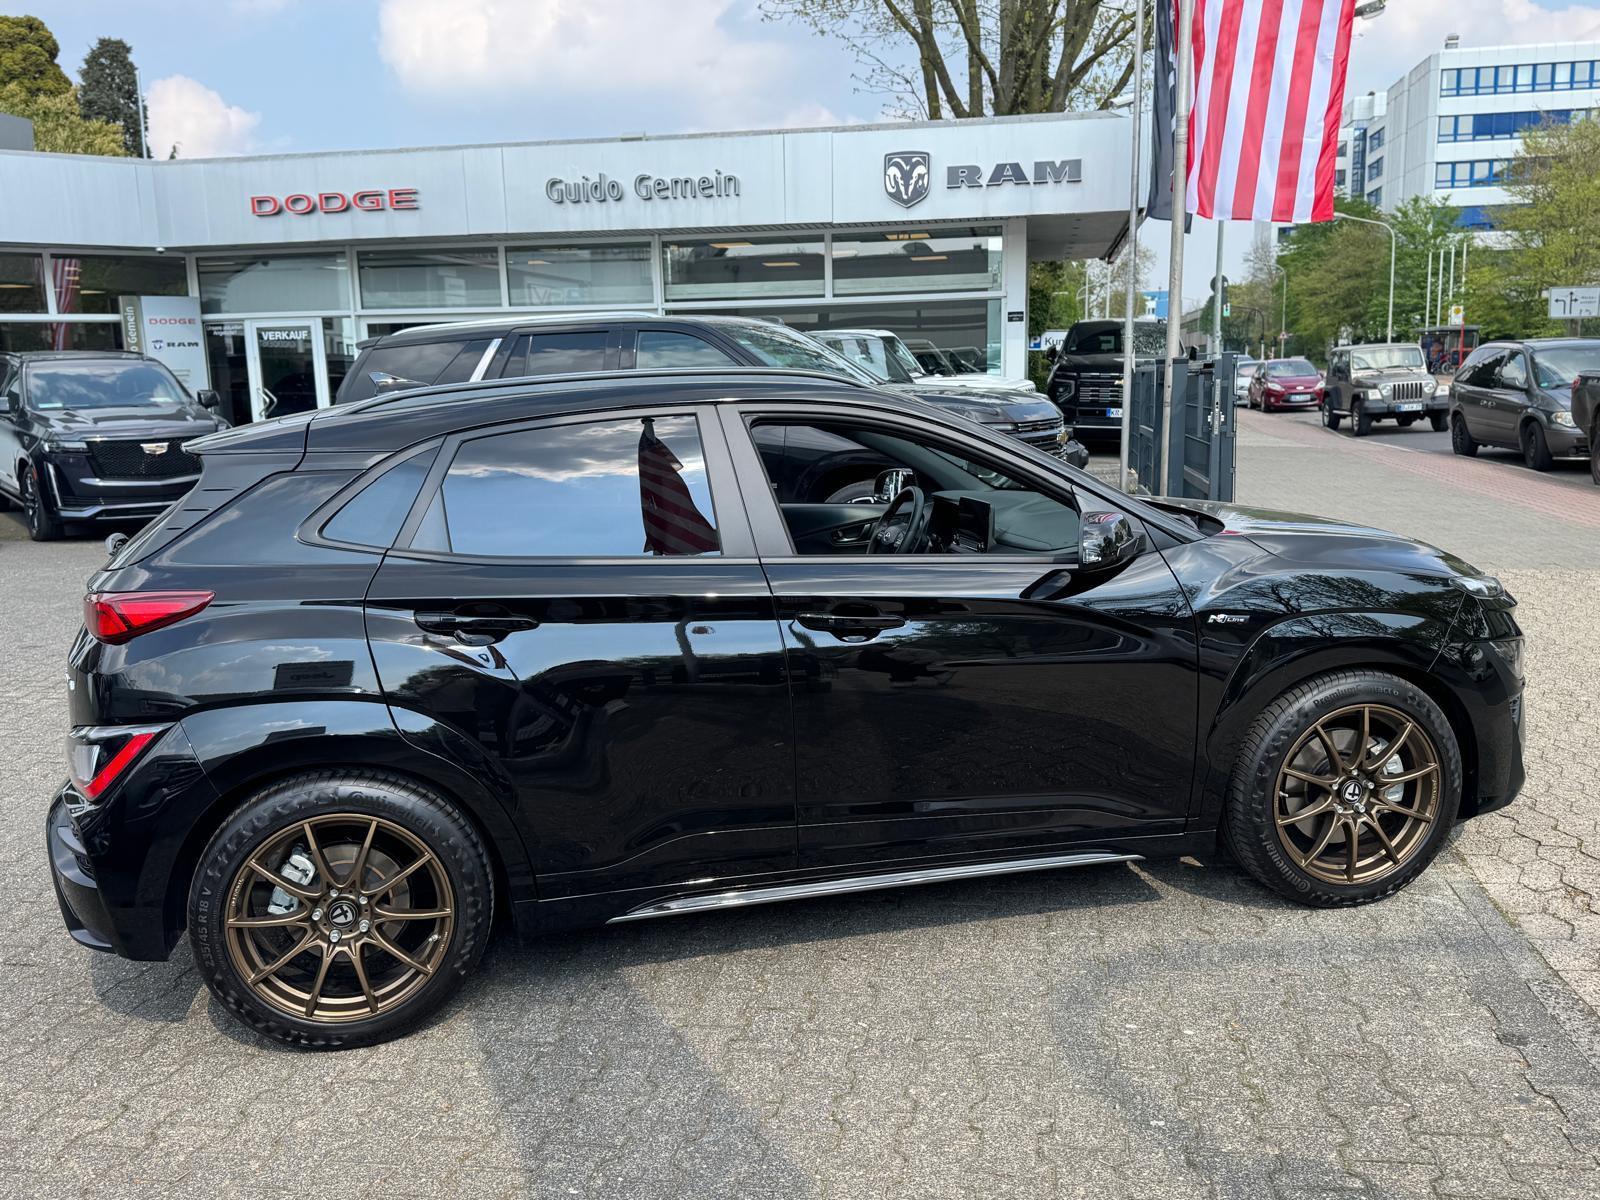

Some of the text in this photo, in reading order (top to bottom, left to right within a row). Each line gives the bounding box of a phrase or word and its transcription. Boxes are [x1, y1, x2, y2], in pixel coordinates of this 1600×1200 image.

[545, 168, 741, 204] Guido Gemein
[946, 158, 1082, 188] RAM
[250, 188, 421, 216] DODGE
[124, 306, 138, 344] Gemein
[261, 330, 309, 341] VERKAUF
[1261, 840, 1312, 893] Continental
